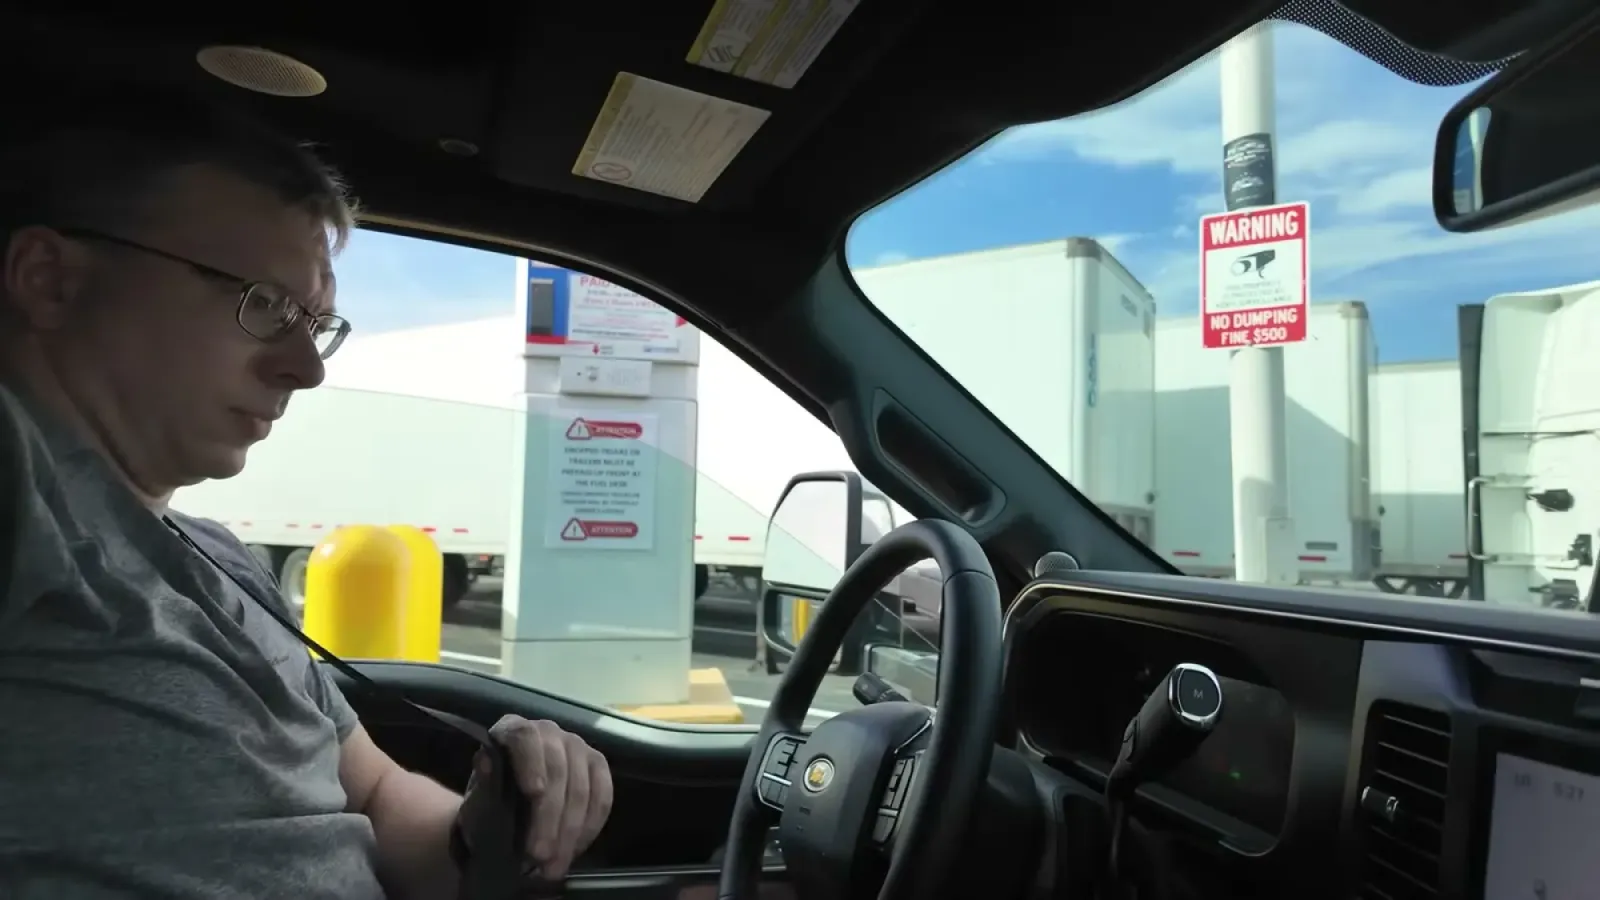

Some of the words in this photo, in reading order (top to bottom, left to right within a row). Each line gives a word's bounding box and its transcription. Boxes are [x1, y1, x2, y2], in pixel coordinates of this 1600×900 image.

[1210, 211, 1299, 246] WARNING
[1210, 314, 1230, 330] NO
[1232, 308, 1298, 328] DUMPING
[1220, 330, 1249, 345] FINE
[1252, 327, 1288, 344] $500
[595, 426, 637, 435] ATTENTION
[590, 480, 607, 488] FUEL
[591, 525, 633, 534] ATTENTION
[1193, 688, 1204, 699] M
